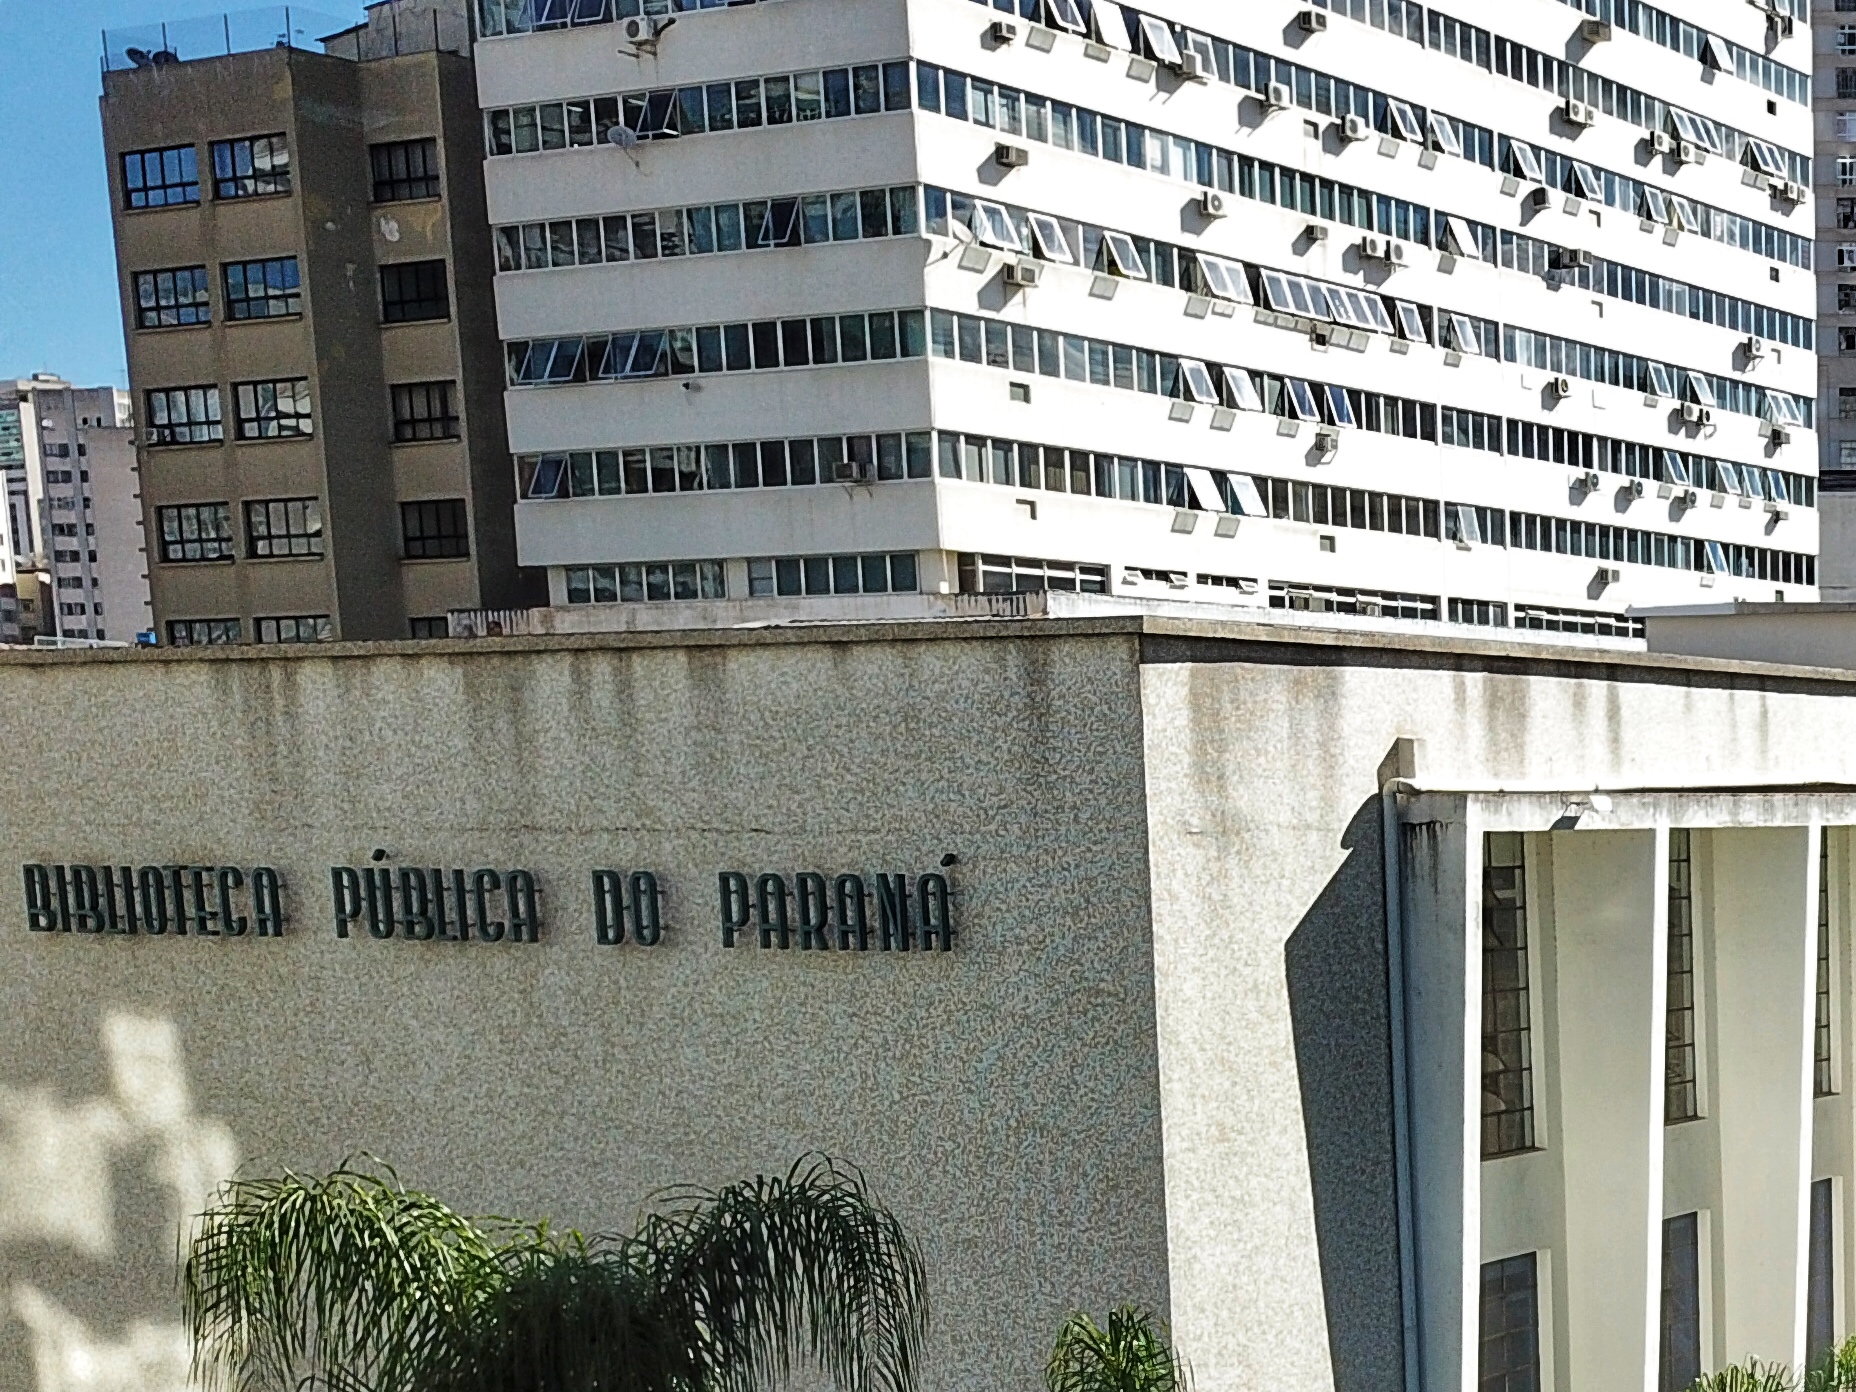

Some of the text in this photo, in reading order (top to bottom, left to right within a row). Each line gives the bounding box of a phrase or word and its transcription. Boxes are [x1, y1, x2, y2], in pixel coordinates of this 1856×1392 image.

[22, 848, 955, 952] BIBLIOTECA PÚBLICA DO PARANÁ
